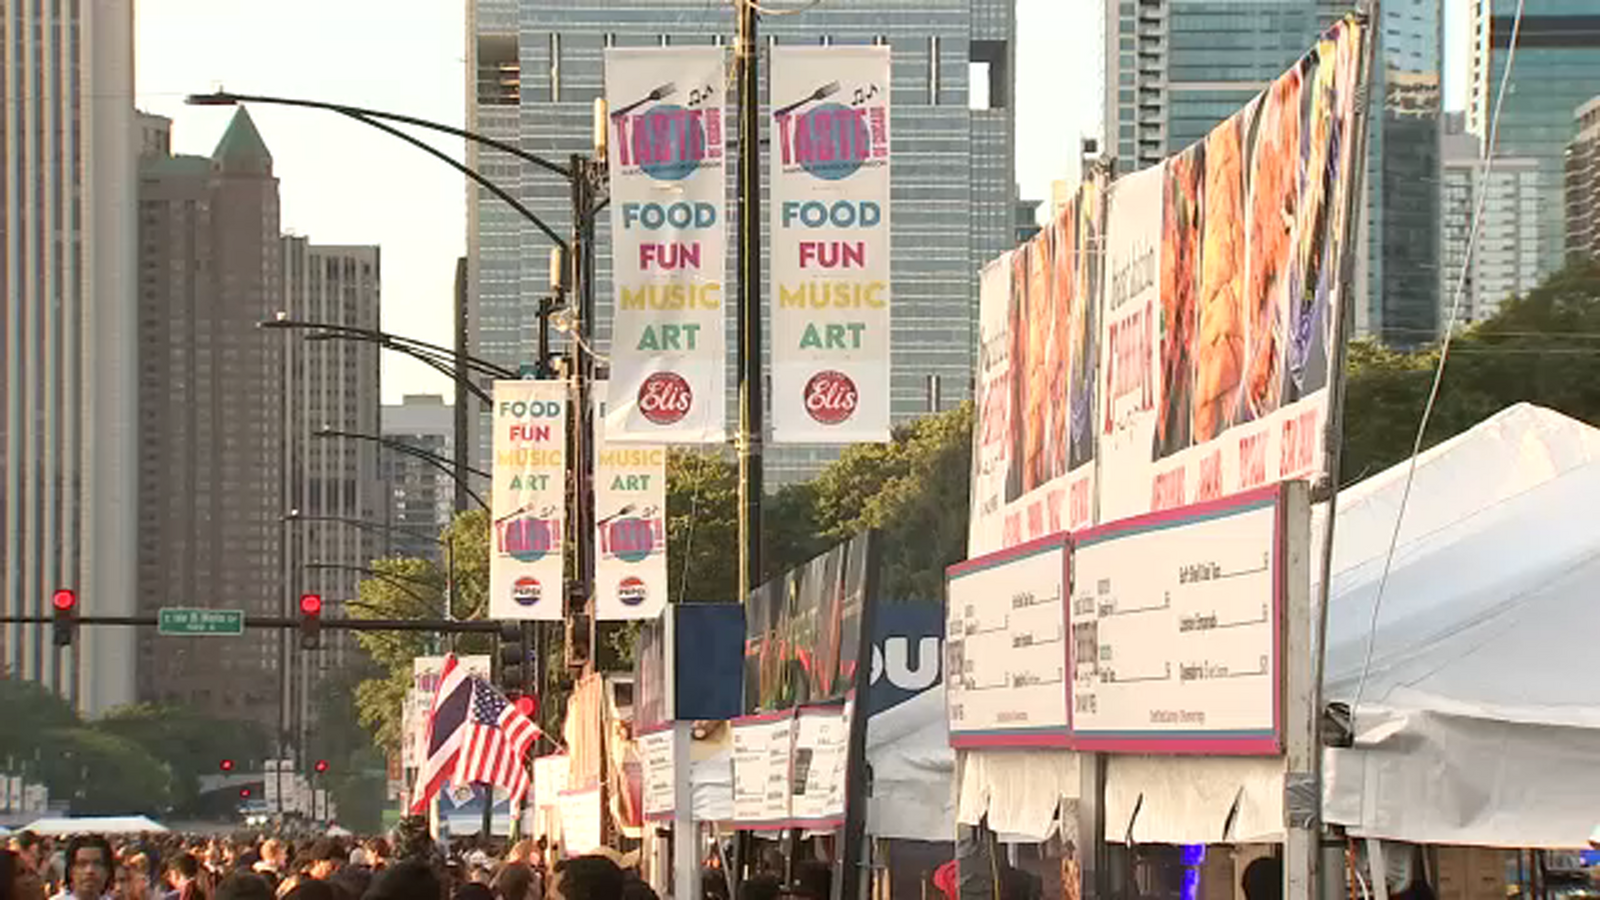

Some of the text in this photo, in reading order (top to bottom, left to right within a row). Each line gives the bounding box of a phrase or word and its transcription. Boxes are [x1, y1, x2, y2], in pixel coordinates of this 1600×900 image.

[611, 109, 705, 166] TASTE
[774, 108, 869, 165] TASTE
[622, 202, 716, 230] FOOD
[782, 201, 881, 228] FOOD
[640, 243, 701, 270] FUN
[799, 242, 865, 268] FUN
[620, 283, 721, 310] MUSIC
[779, 282, 887, 309] MUSIC
[637, 324, 701, 350] ART
[799, 322, 866, 349] ART
[500, 401, 561, 418] FOOD
[509, 426, 550, 442] FUN
[498, 451, 561, 466] MUSIC
[600, 450, 662, 466] MUSIC
[509, 475, 550, 490] ART
[610, 474, 651, 490] ART
